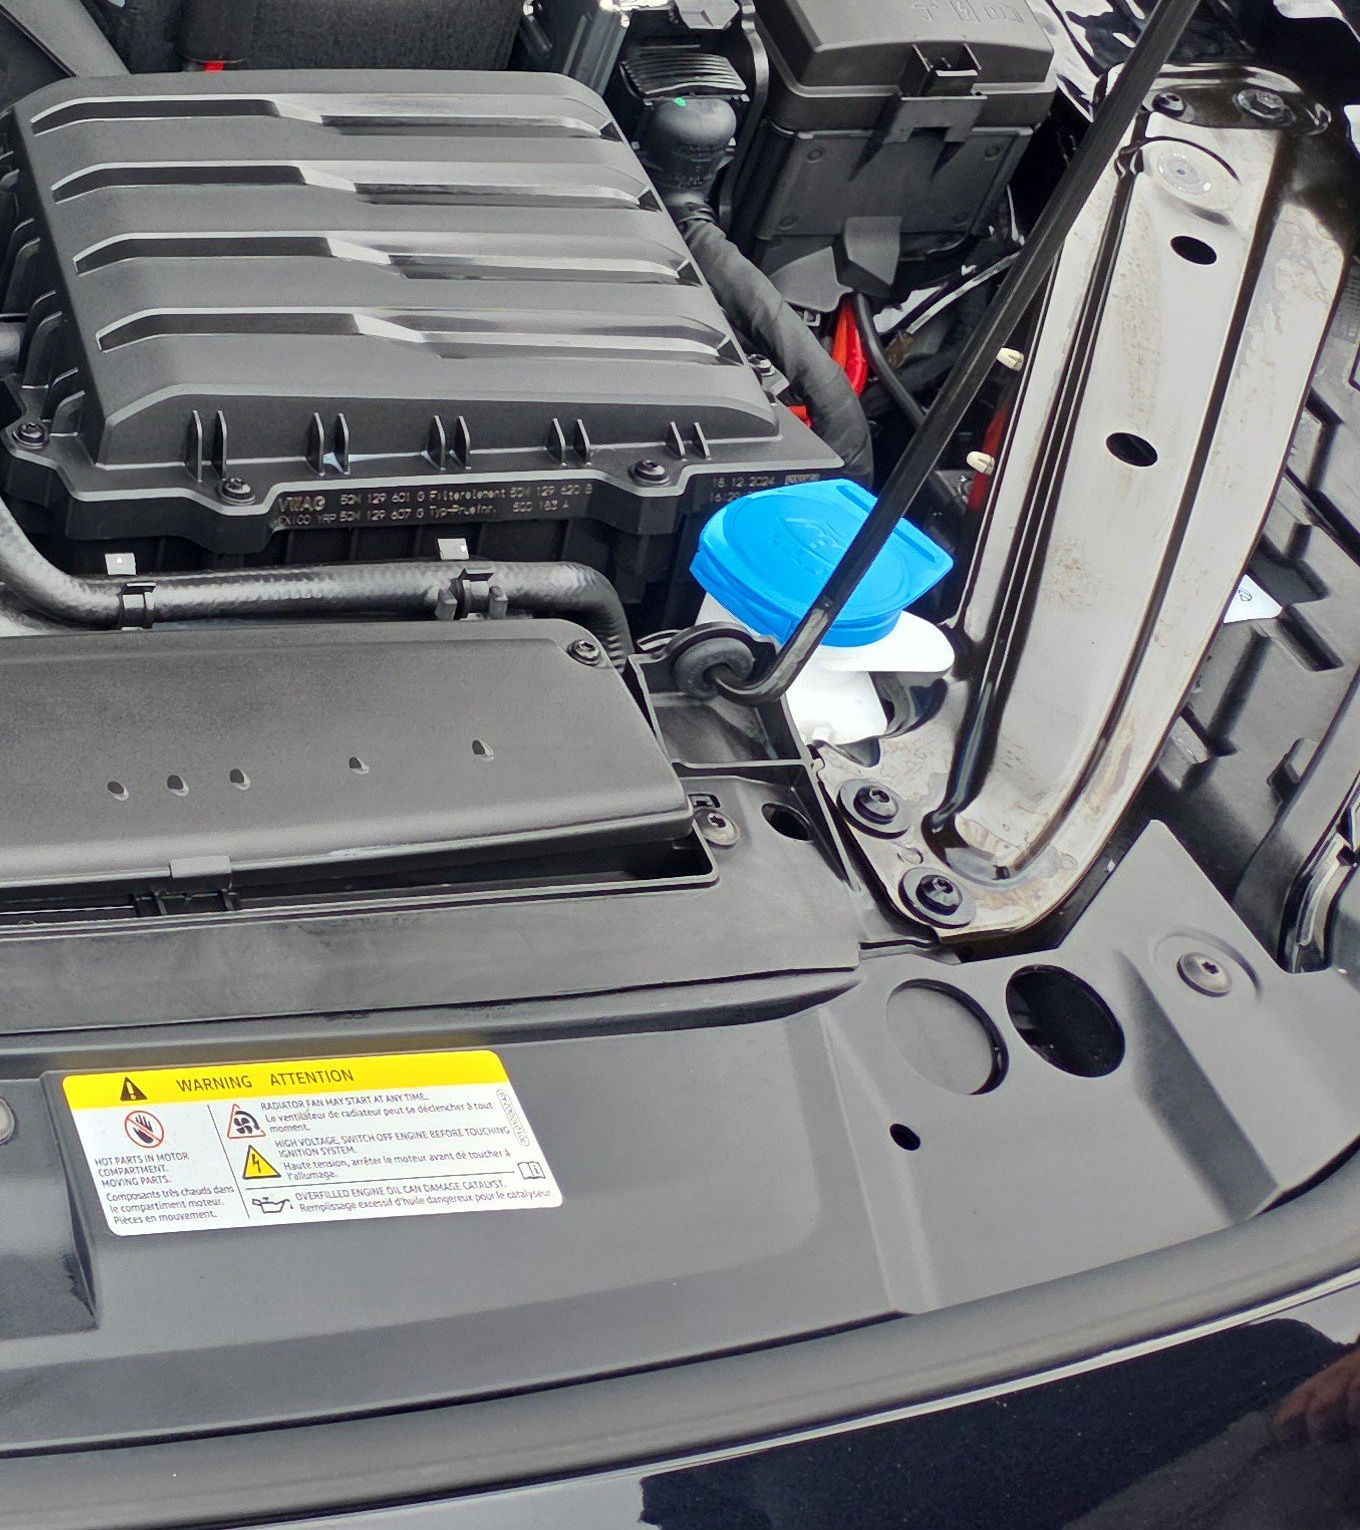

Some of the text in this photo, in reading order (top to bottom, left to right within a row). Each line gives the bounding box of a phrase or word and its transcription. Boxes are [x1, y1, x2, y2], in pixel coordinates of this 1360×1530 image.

[175, 1068, 355, 1093] WARNING ATTENTION
[260, 1100, 305, 1111] RADIATOR
[306, 1099, 324, 1108] FAN
[326, 1097, 344, 1107] MAY
[345, 1096, 372, 1106] START
[374, 1094, 384, 1103] AT
[386, 1093, 403, 1103] ANY
[265, 1113, 276, 1123] Le
[278, 1111, 326, 1122] ventilateur
[328, 1110, 340, 1119] de
[341, 1108, 381, 1119] radiateur
[384, 1106, 404, 1117] peut
[417, 1102, 465, 1114] déclencher
[474, 1101, 494, 1110] tout
[274, 1138, 298, 1148] HIGH
[341, 1133, 375, 1144] SWITCH
[376, 1132, 393, 1141] OFF
[395, 1129, 429, 1141] ENGINE
[430, 1127, 463, 1139] BEFORE
[465, 1125, 510, 1137] TOUCHING
[94, 1151, 190, 1167] HOT PARTS IN MOTOR
[278, 1147, 319, 1159] IGNITION
[283, 1160, 312, 1171] Haute
[351, 1155, 381, 1166] arrêter
[394, 1152, 427, 1163] moteur
[429, 1150, 455, 1161] avant
[468, 1148, 502, 1159] toucher
[98, 1164, 170, 1178] COMPARTMENT.
[102, 1175, 172, 1188] MOVING PARTS.
[295, 1179, 508, 1202] OVERFILLED ENGINE OIL CAN DAMAGE CATALYST.
[106, 1184, 235, 1203] Composants très chauds dans
[299, 1201, 357, 1213] Remplissage
[358, 1197, 393, 1208] excessif
[394, 1195, 425, 1207] d'huile
[426, 1192, 473, 1205] dangereux
[474, 1192, 495, 1202] pour
[120, 1200, 187, 1213] compartiment
[113, 1213, 144, 1226] Pièces
[145, 1214, 157, 1222] en
